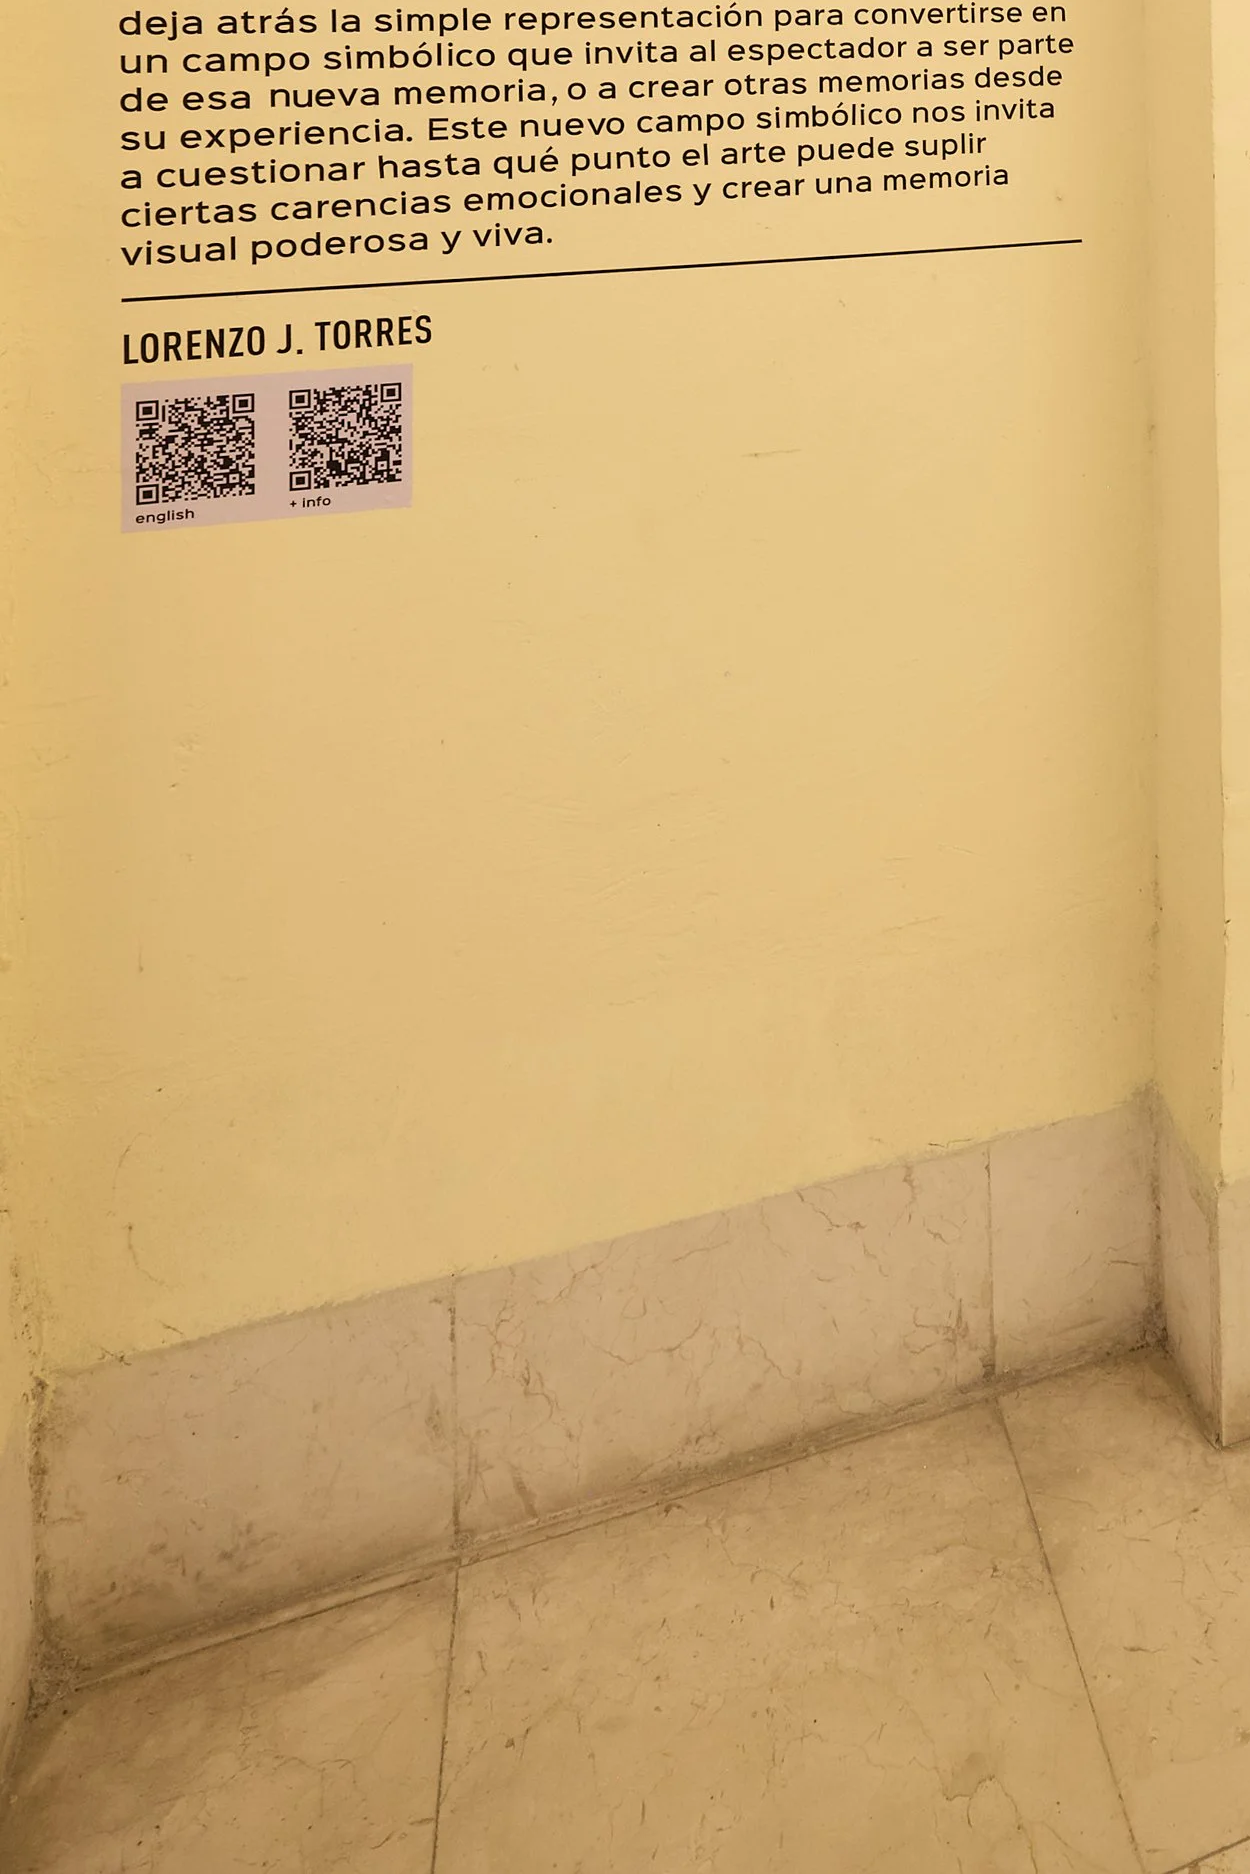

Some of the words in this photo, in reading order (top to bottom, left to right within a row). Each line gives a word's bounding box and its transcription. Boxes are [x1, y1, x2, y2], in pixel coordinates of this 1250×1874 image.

[120, 54, 168, 74] un
[182, 51, 310, 77] campo
[323, 41, 496, 70] simbólico
[507, 47, 573, 72] que
[585, 40, 678, 65] invita
[689, 39, 716, 63] al
[727, 36, 908, 66] espectador
[916, 40, 933, 58] a
[943, 39, 990, 57] ser
[998, 34, 1074, 61] parte
[120, 130, 166, 151] su
[180, 118, 413, 154] experiencia.
[428, 116, 508, 141] Este
[520, 117, 625, 138] nuevo
[636, 112, 745, 137] campo
[756, 101, 902, 130] simbólico
[912, 105, 966, 124] nos
[975, 98, 1055, 122] invita
[121, 200, 257, 228] ciertas
[270, 190, 451, 221] carencias
[463, 180, 682, 212] emocionales
[692, 182, 712, 206] y
[722, 178, 805, 200] crear
[815, 175, 872, 195] una
[883, 164, 1009, 192] memoria
[120, 235, 236, 266] visual
[251, 231, 428, 266] poderosa
[440, 230, 462, 255] y
[472, 222, 553, 247] viva.
[123, 323, 266, 365] LORENZO
[276, 323, 304, 356] J.
[314, 314, 433, 351] TORRES
[135, 508, 195, 524] english
[289, 499, 297, 509] +
[301, 495, 332, 509] info
